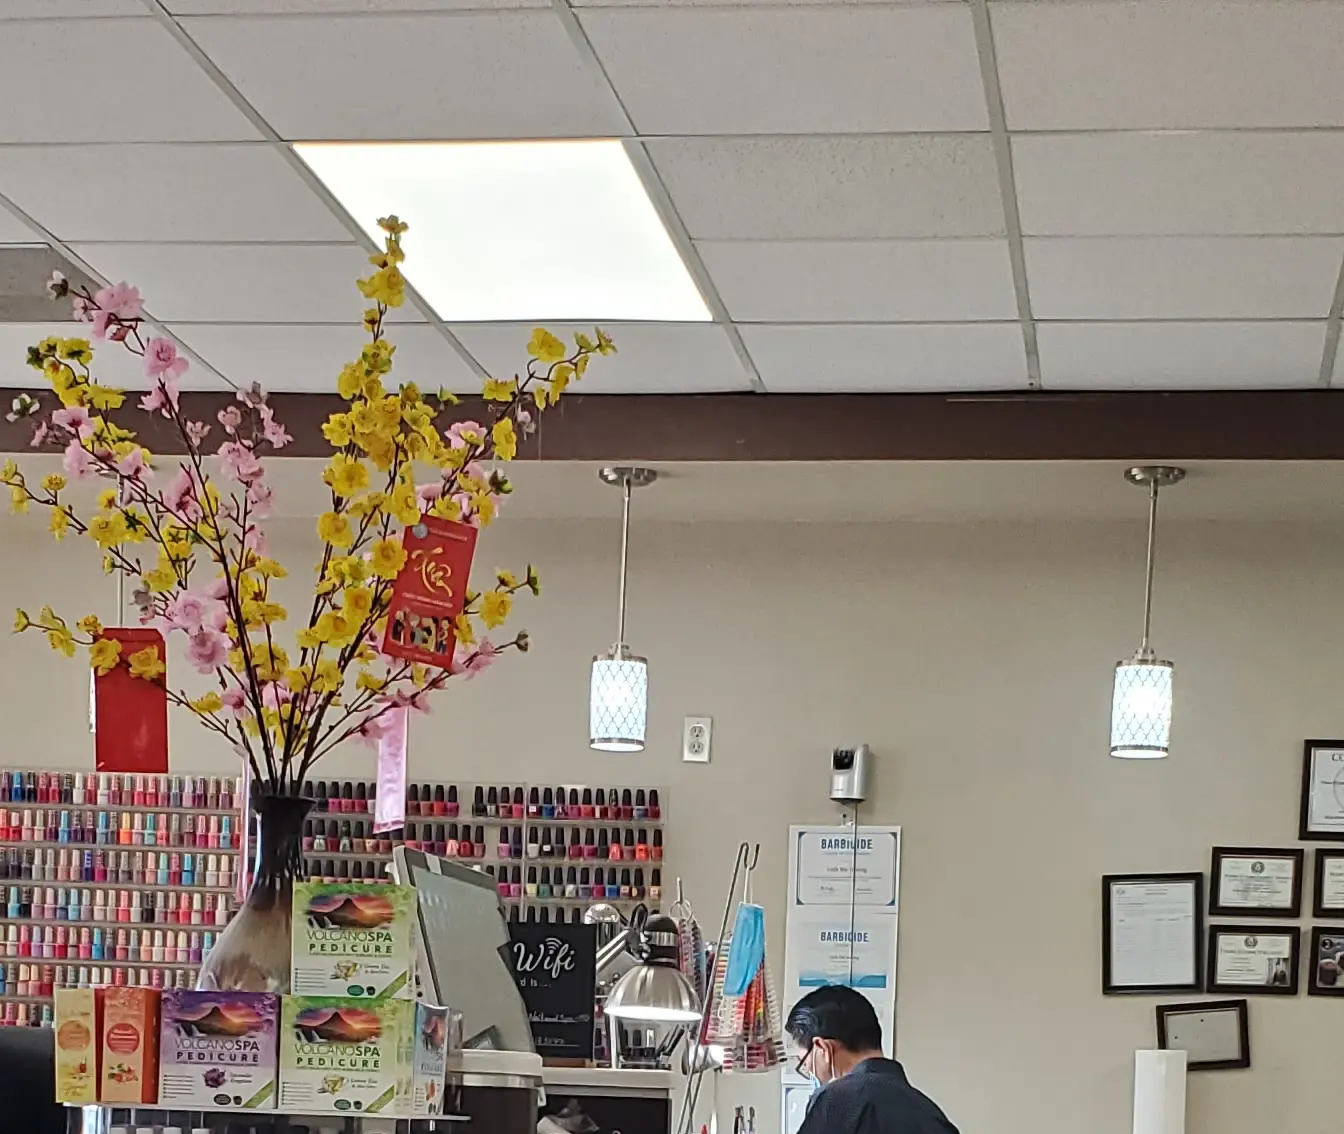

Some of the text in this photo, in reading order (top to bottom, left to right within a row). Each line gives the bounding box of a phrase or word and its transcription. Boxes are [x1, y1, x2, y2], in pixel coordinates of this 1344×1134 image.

[820, 931, 869, 942] BARBICIDE
[309, 943, 393, 954] PEDICURE
[513, 941, 575, 978] Wifi
[176, 1051, 259, 1062] PEDICURE
[296, 1056, 380, 1069] PEDICURE
